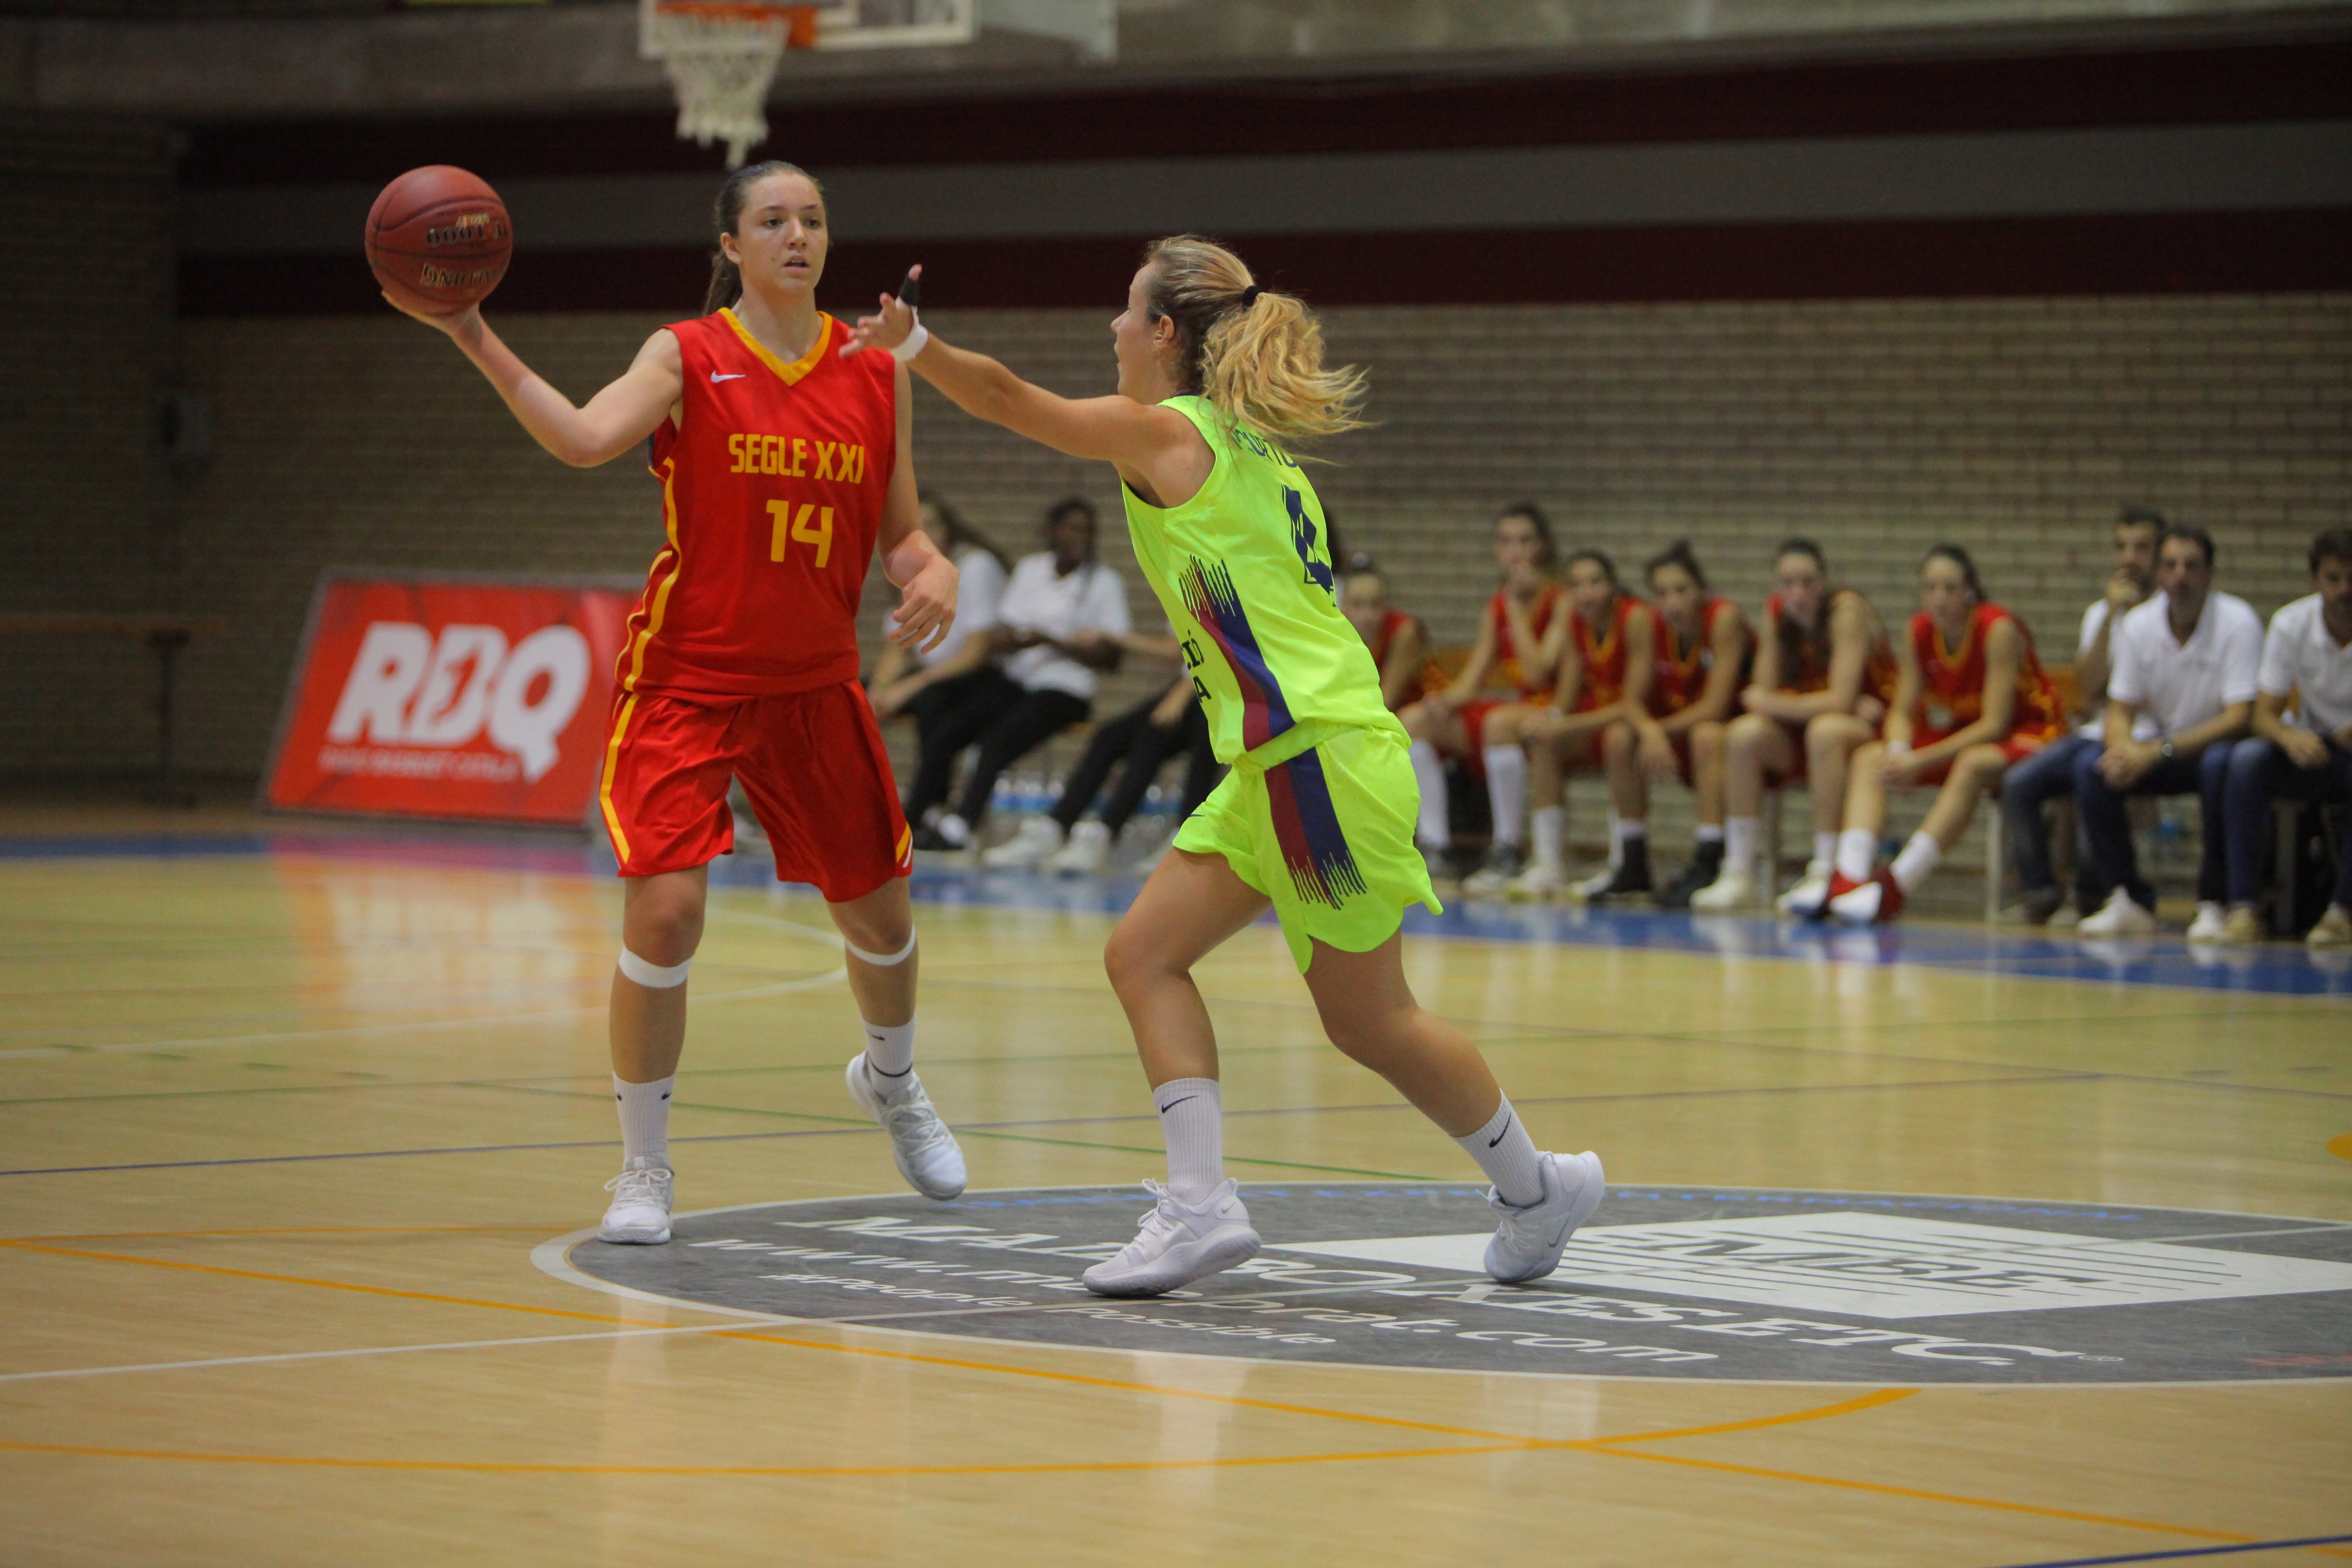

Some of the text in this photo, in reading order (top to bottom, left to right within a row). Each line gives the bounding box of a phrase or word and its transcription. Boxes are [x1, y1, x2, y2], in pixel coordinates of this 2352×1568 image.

[729, 433, 864, 484] SEGLE XXI
[766, 499, 834, 568] 14
